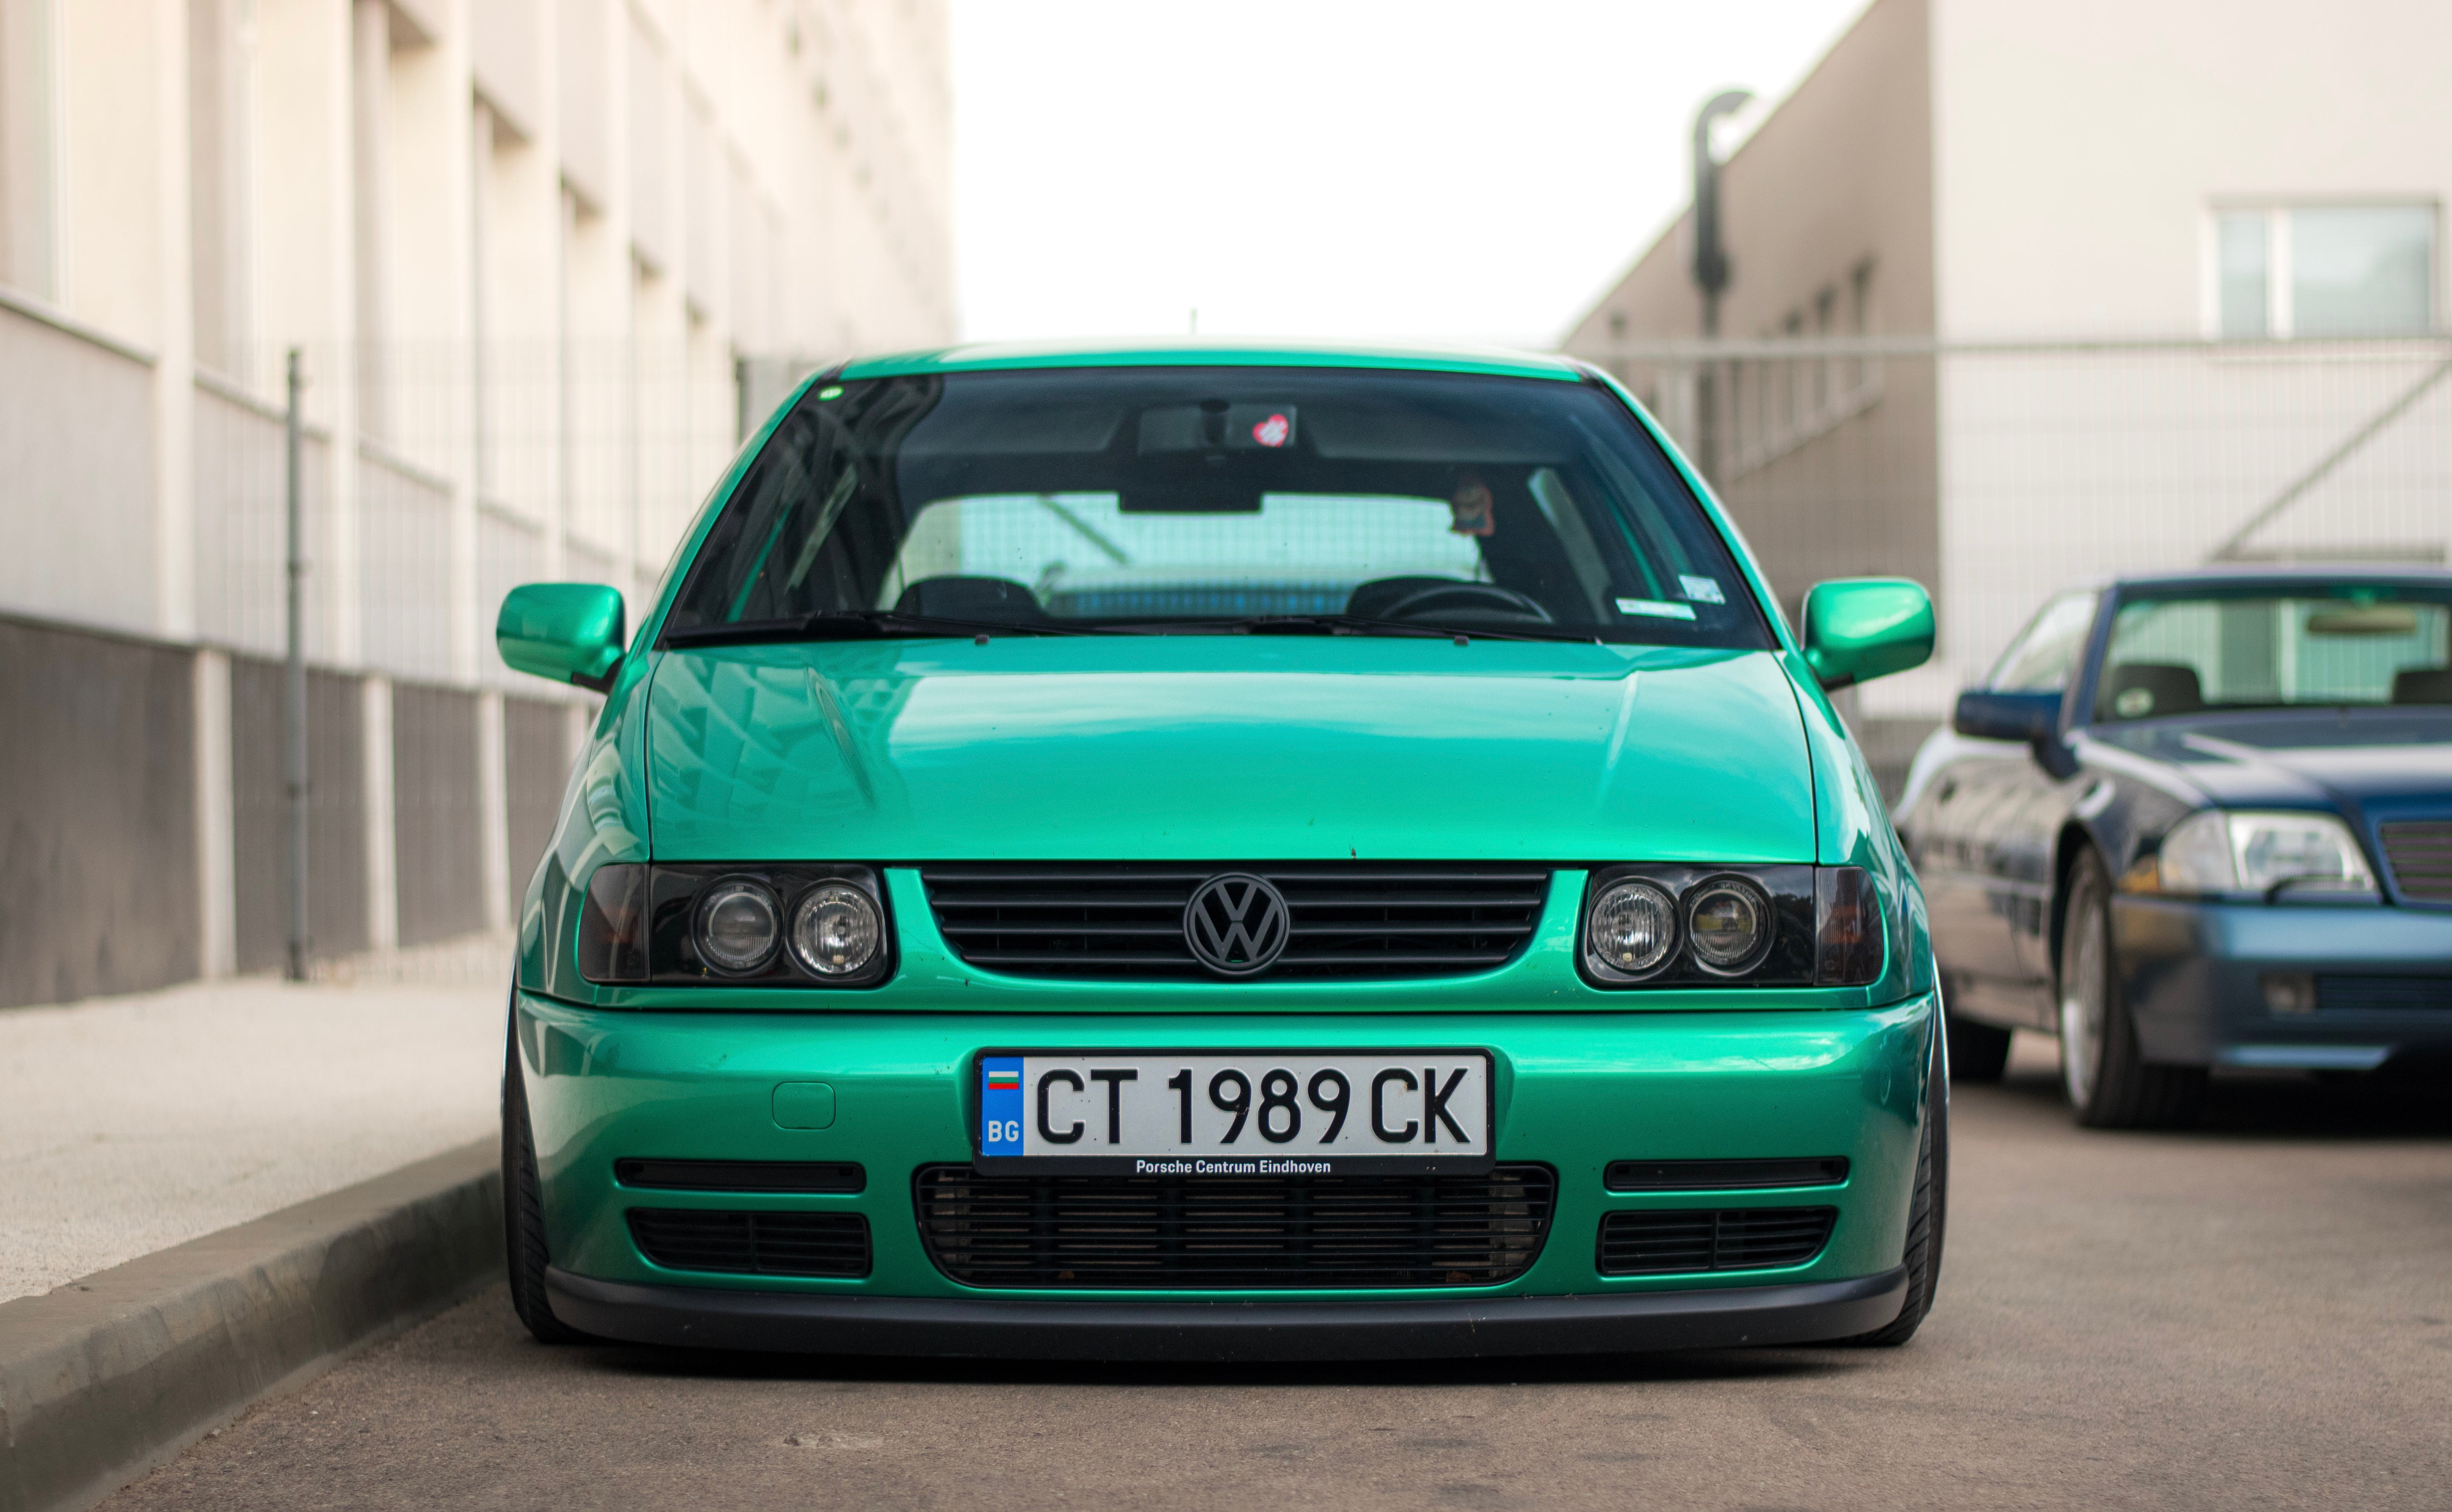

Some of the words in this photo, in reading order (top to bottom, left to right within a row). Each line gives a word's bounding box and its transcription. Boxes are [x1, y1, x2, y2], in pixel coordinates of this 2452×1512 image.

[1190, 876, 1283, 969] VW
[1037, 1068, 1138, 1144] CT
[1169, 1068, 1351, 1144] 1989
[1371, 1068, 1471, 1143] CK
[988, 1121, 1019, 1142] BG
[1137, 1160, 1192, 1173] Porsche
[1196, 1160, 1255, 1173] Centrum
[1260, 1160, 1331, 1173] Eindhoven
